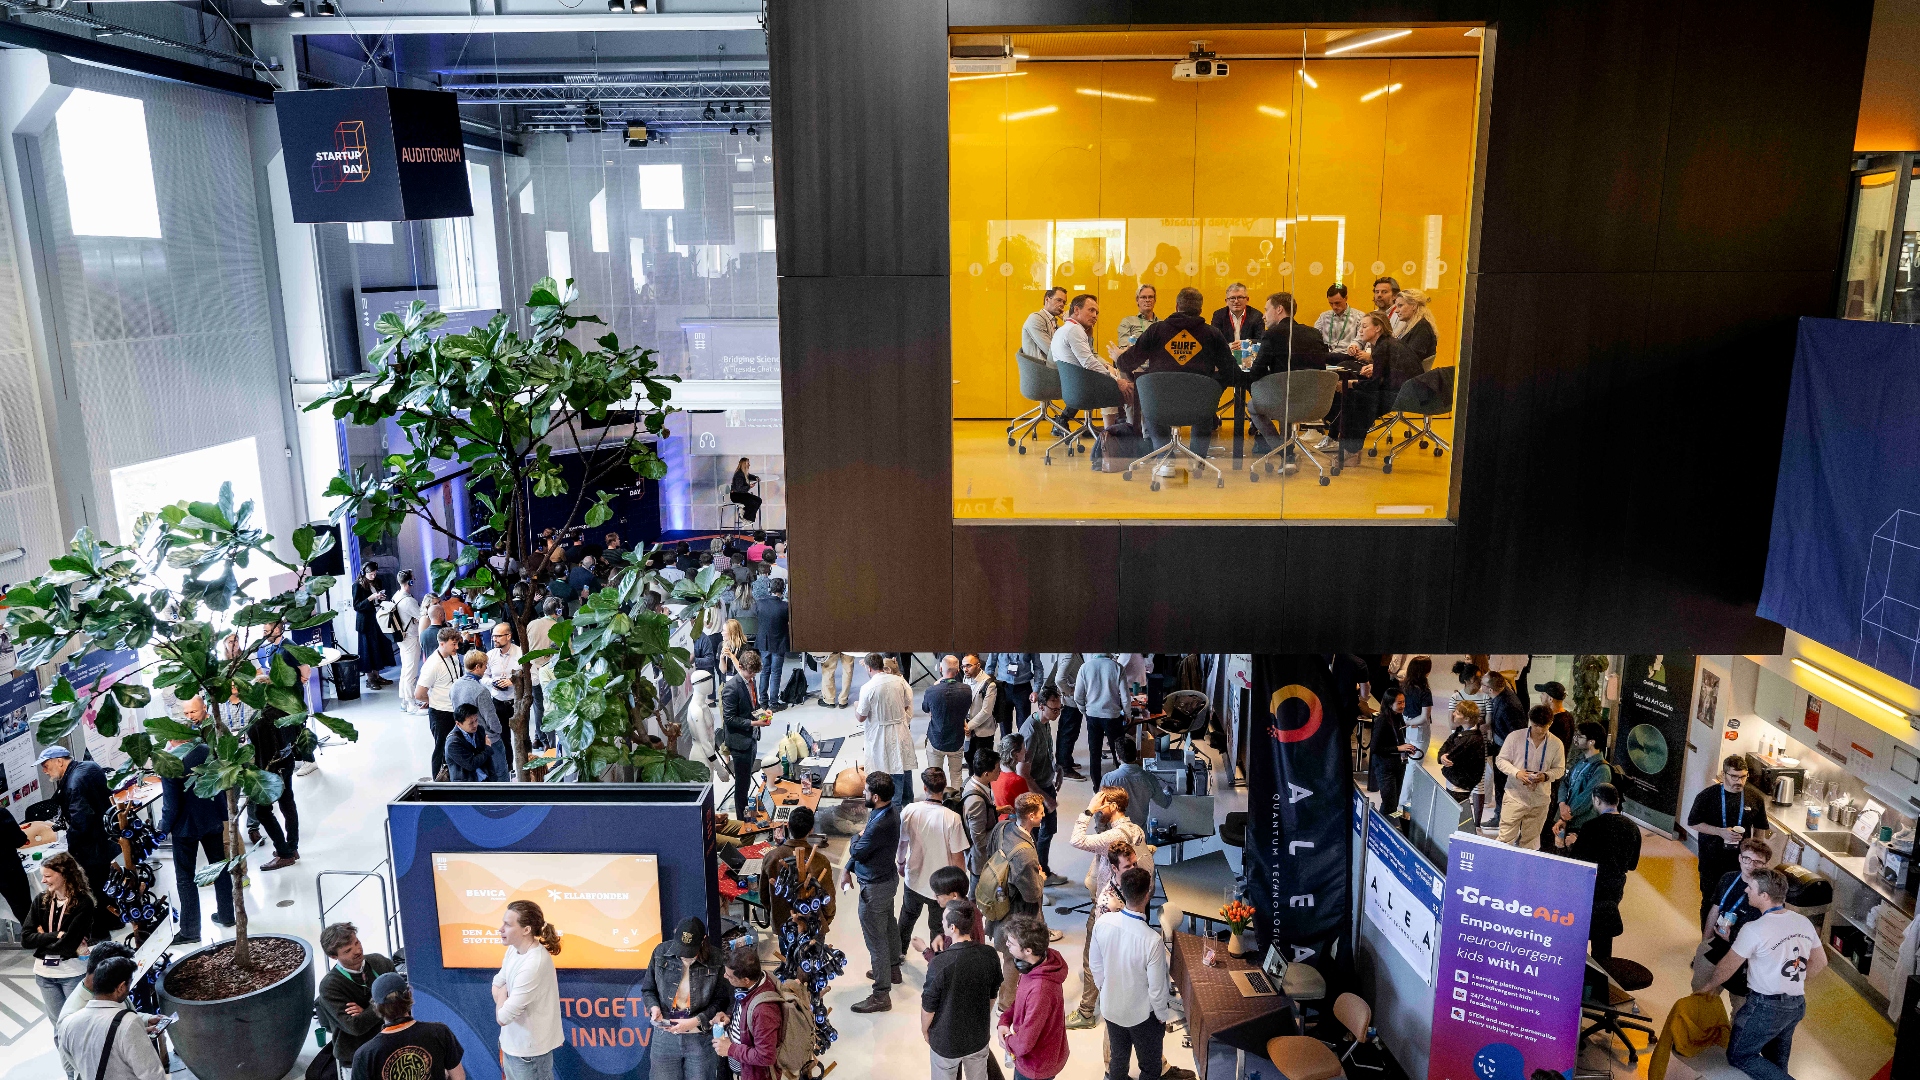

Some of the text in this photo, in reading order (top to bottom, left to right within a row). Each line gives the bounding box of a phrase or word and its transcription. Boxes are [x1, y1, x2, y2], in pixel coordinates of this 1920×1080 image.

[316, 151, 361, 161] STARTUP
[402, 147, 461, 163] AUDITORIUM
[343, 165, 362, 174] DAY
[1171, 341, 1196, 350] SURF
[723, 356, 754, 364] Bridging
[1633, 692, 1644, 700] Your
[1272, 793, 1280, 856] QUANTUM
[1460, 851, 1474, 860] DTU
[1287, 781, 1316, 963] ALEA
[564, 892, 629, 900] ELLABFONDEN
[1456, 885, 1575, 926] GradeAid
[1371, 876, 1430, 950] ALEA
[1460, 913, 1553, 948] Empowering
[1458, 932, 1564, 966] neurodivergent
[1456, 947, 1539, 977] kids with AI
[1471, 981, 1519, 998] neurodivergent
[1472, 973, 1499, 986] Learning
[1499, 981, 1527, 993] platform
[1527, 988, 1552, 1000] tailored
[560, 997, 650, 1018] TOGET
[1469, 999, 1499, 1011] feedback
[1470, 992, 1484, 1000] 24/7
[1492, 998, 1509, 1007] Tutor
[1509, 1004, 1534, 1014] support
[1467, 1019, 1538, 1043] every subject your way
[1468, 1011, 1485, 1020] STEM
[1498, 1020, 1515, 1029] more
[1520, 1027, 1557, 1041] personalize
